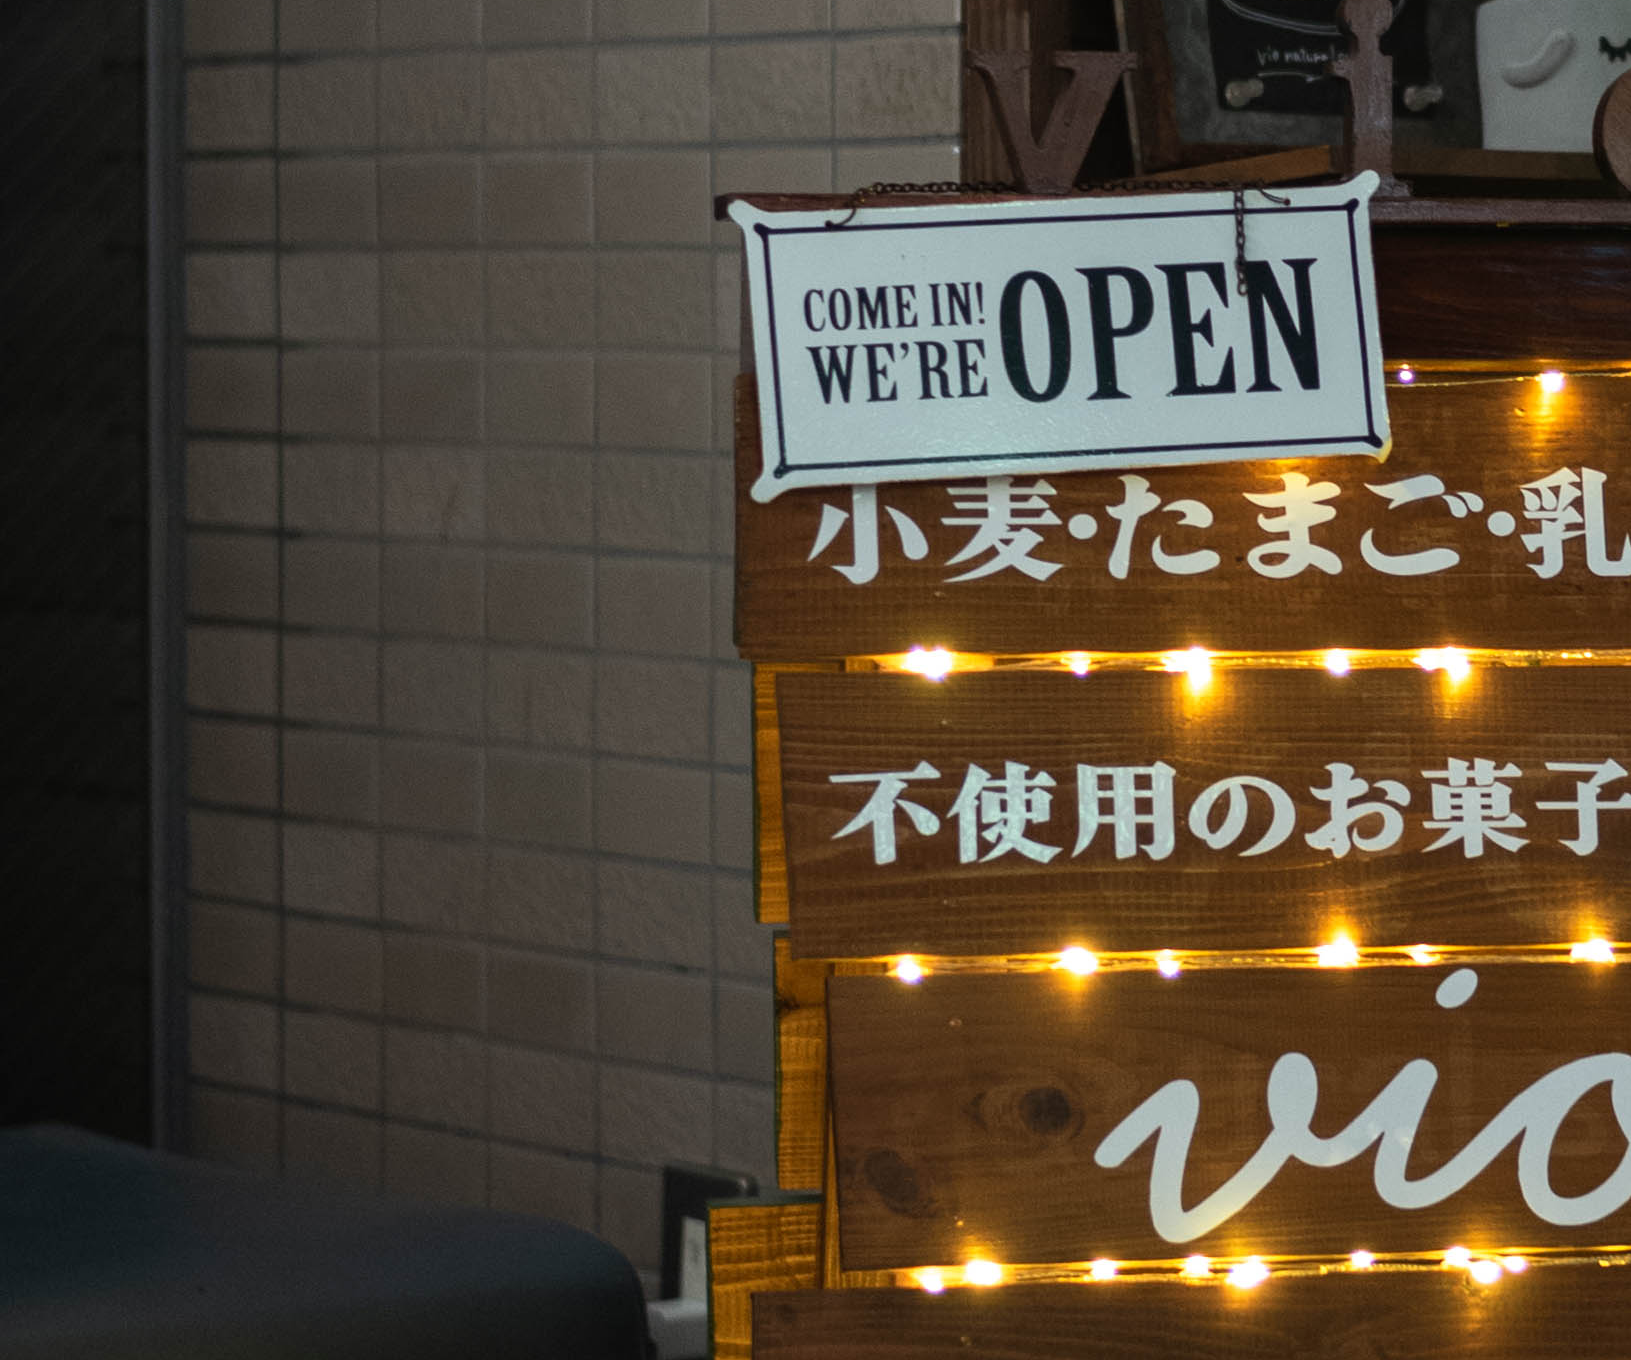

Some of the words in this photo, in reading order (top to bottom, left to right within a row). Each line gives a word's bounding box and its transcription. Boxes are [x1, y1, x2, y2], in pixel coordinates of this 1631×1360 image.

[803, 284, 918, 332] COME
[929, 281, 984, 327] IN!
[1000, 257, 1320, 403] OPEN
[806, 339, 988, 404] WE'RE
